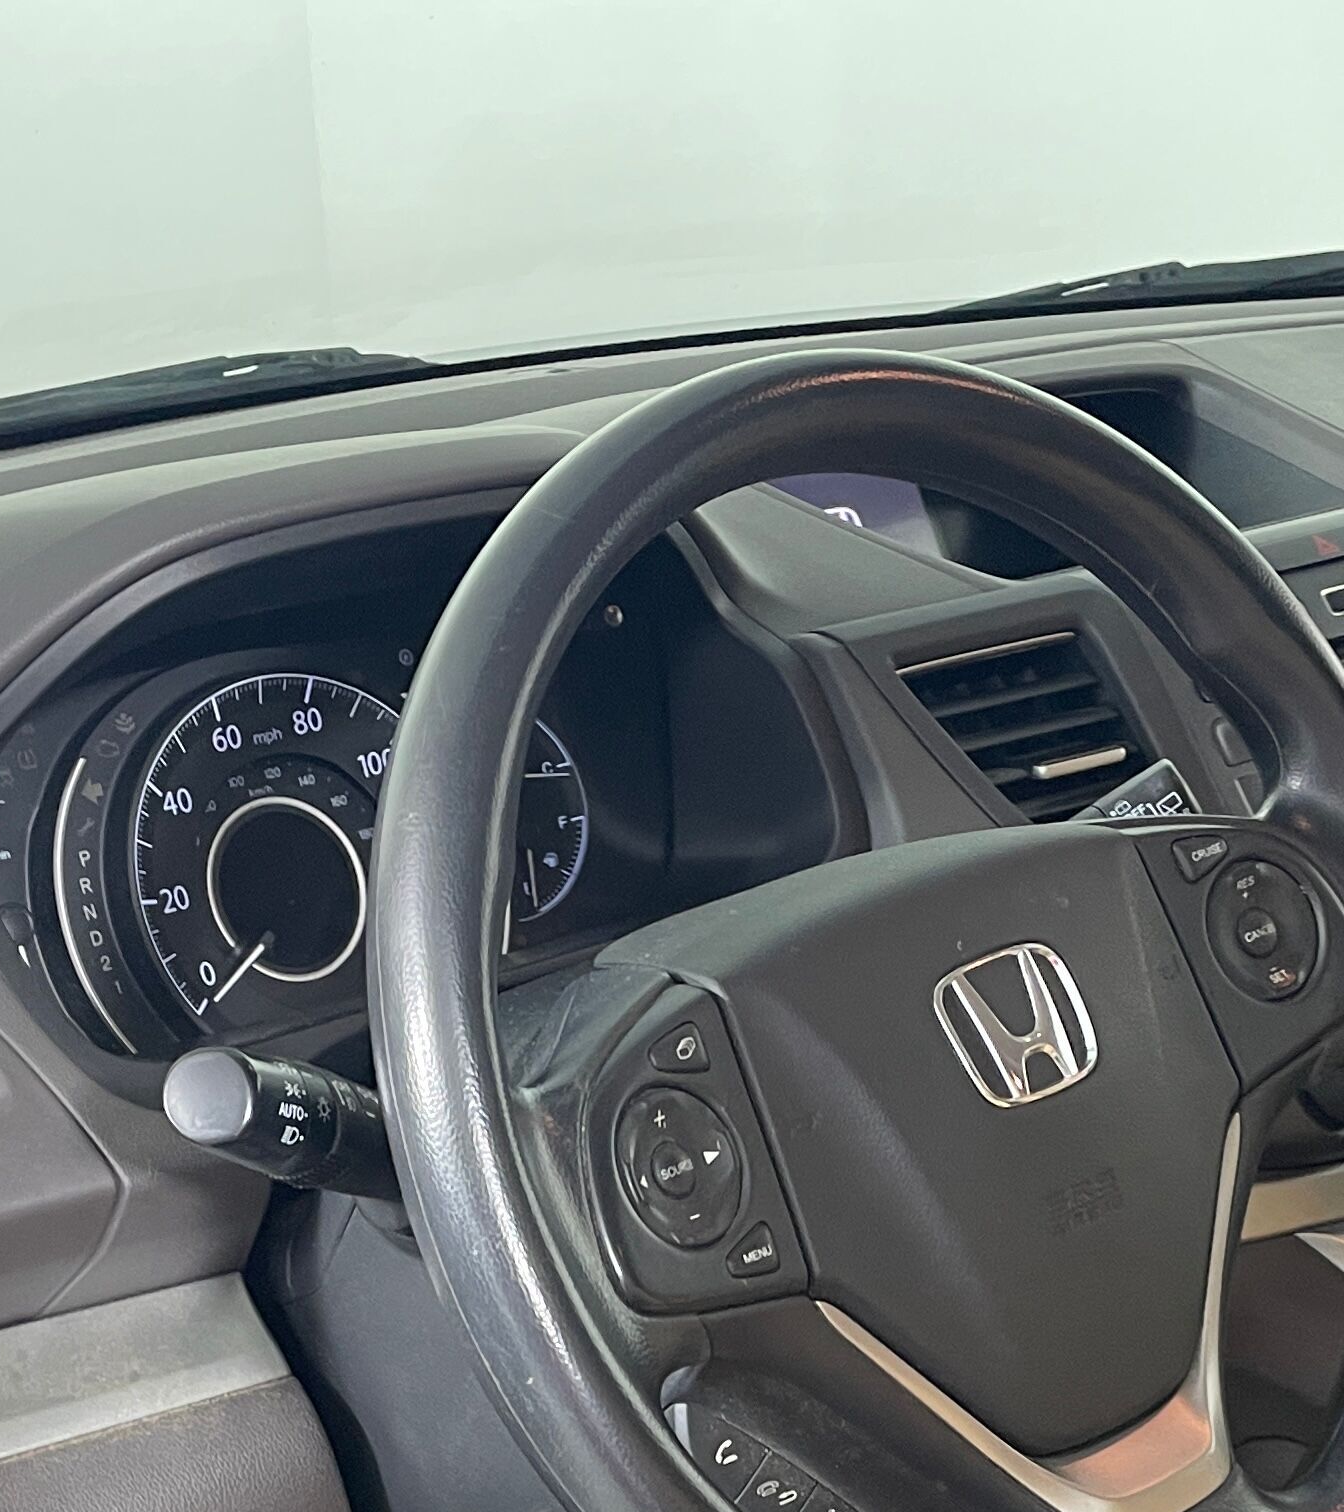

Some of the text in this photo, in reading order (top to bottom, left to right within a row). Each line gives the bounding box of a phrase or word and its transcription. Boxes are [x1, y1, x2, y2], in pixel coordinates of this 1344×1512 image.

[291, 707, 323, 735] 80
[212, 724, 242, 752] 60
[252, 727, 283, 746] mph
[162, 788, 193, 815] 40
[557, 815, 568, 830] F
[78, 850, 91, 868] P
[1191, 842, 1222, 862] CRUISE
[79, 877, 94, 895] R
[1236, 875, 1256, 891] RES
[159, 885, 189, 914] 20
[82, 903, 98, 921] N
[89, 930, 103, 947] D
[100, 955, 113, 972] 2
[199, 961, 216, 986] 0
[1269, 968, 1290, 984] SET
[278, 1101, 304, 1121] AUTO
[742, 1244, 773, 1264] MENU
